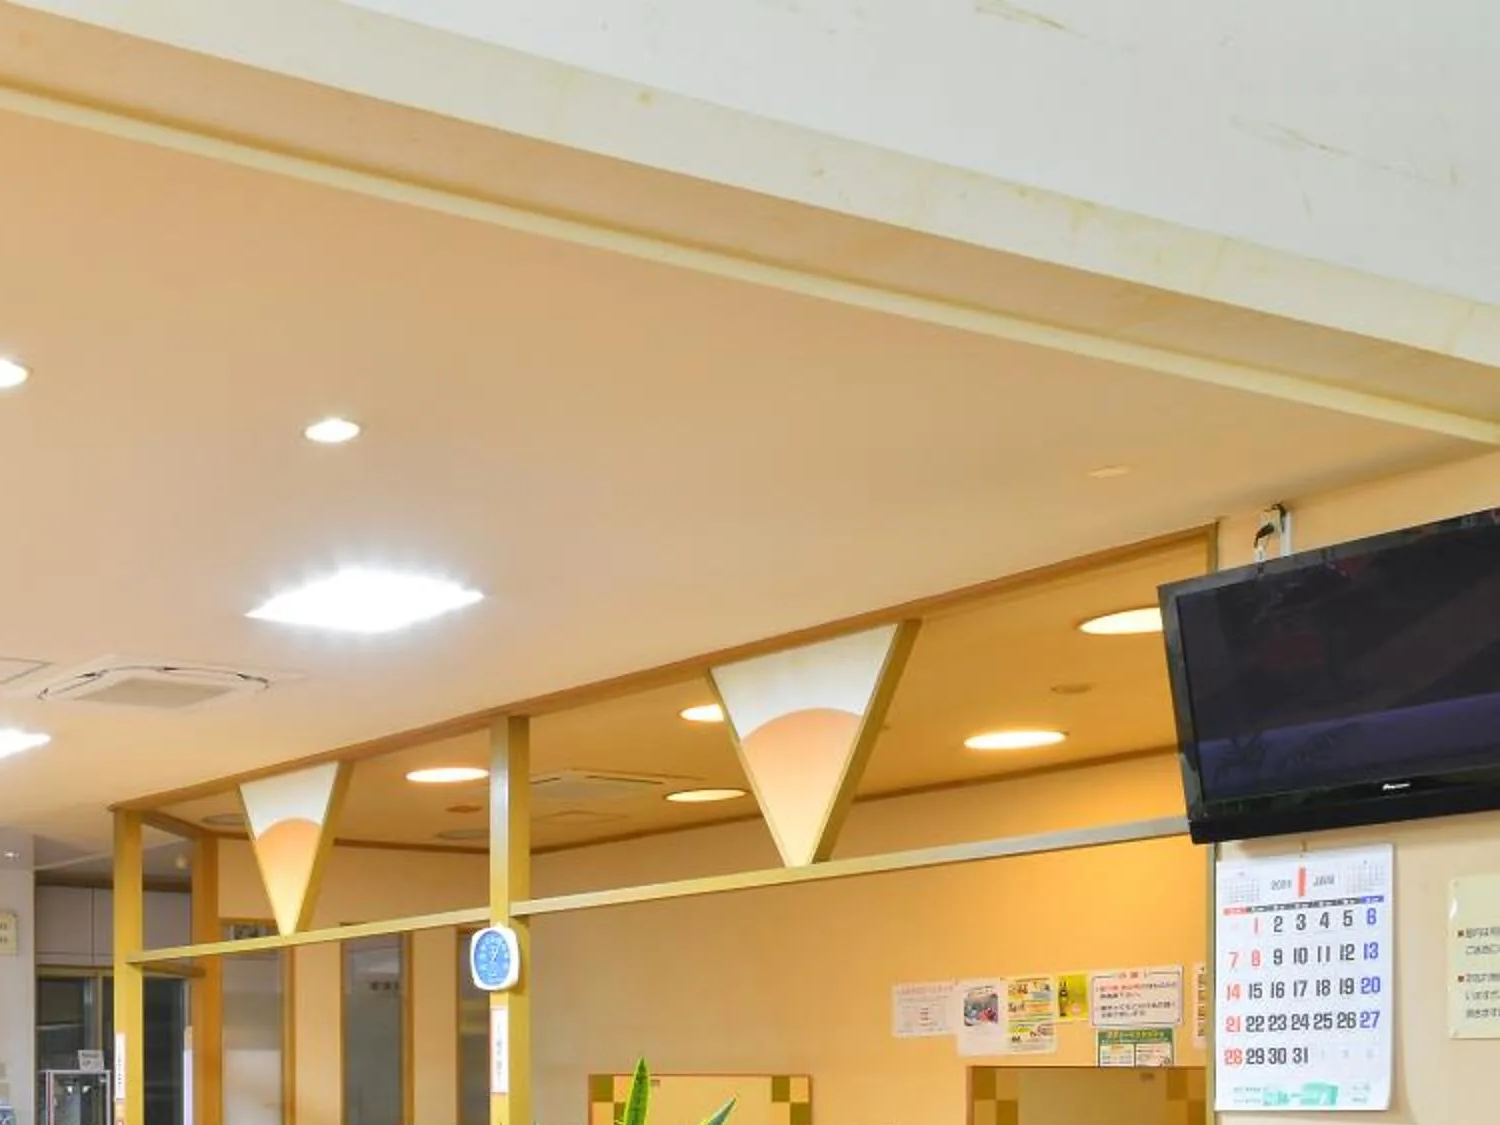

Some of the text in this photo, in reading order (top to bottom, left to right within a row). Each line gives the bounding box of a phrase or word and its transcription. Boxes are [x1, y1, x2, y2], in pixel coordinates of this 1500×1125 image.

[1254, 917, 1259, 934] 1
[1273, 915, 1283, 932] 2
[1296, 914, 1306, 931] 3
[1319, 911, 1330, 929] 4
[1343, 910, 1353, 927] 5
[1228, 942, 1379, 968] 7 8 9 10 11 12 13
[1227, 976, 1381, 1001] 14 15 16 17 18 19 20
[1225, 1010, 1380, 1033] 21 22 23 24 25 26 27
[1224, 1048, 1242, 1065] 28
[1245, 1048, 1265, 1065] 29
[1267, 1047, 1287, 1065] 30
[1292, 1047, 1309, 1064] 31
